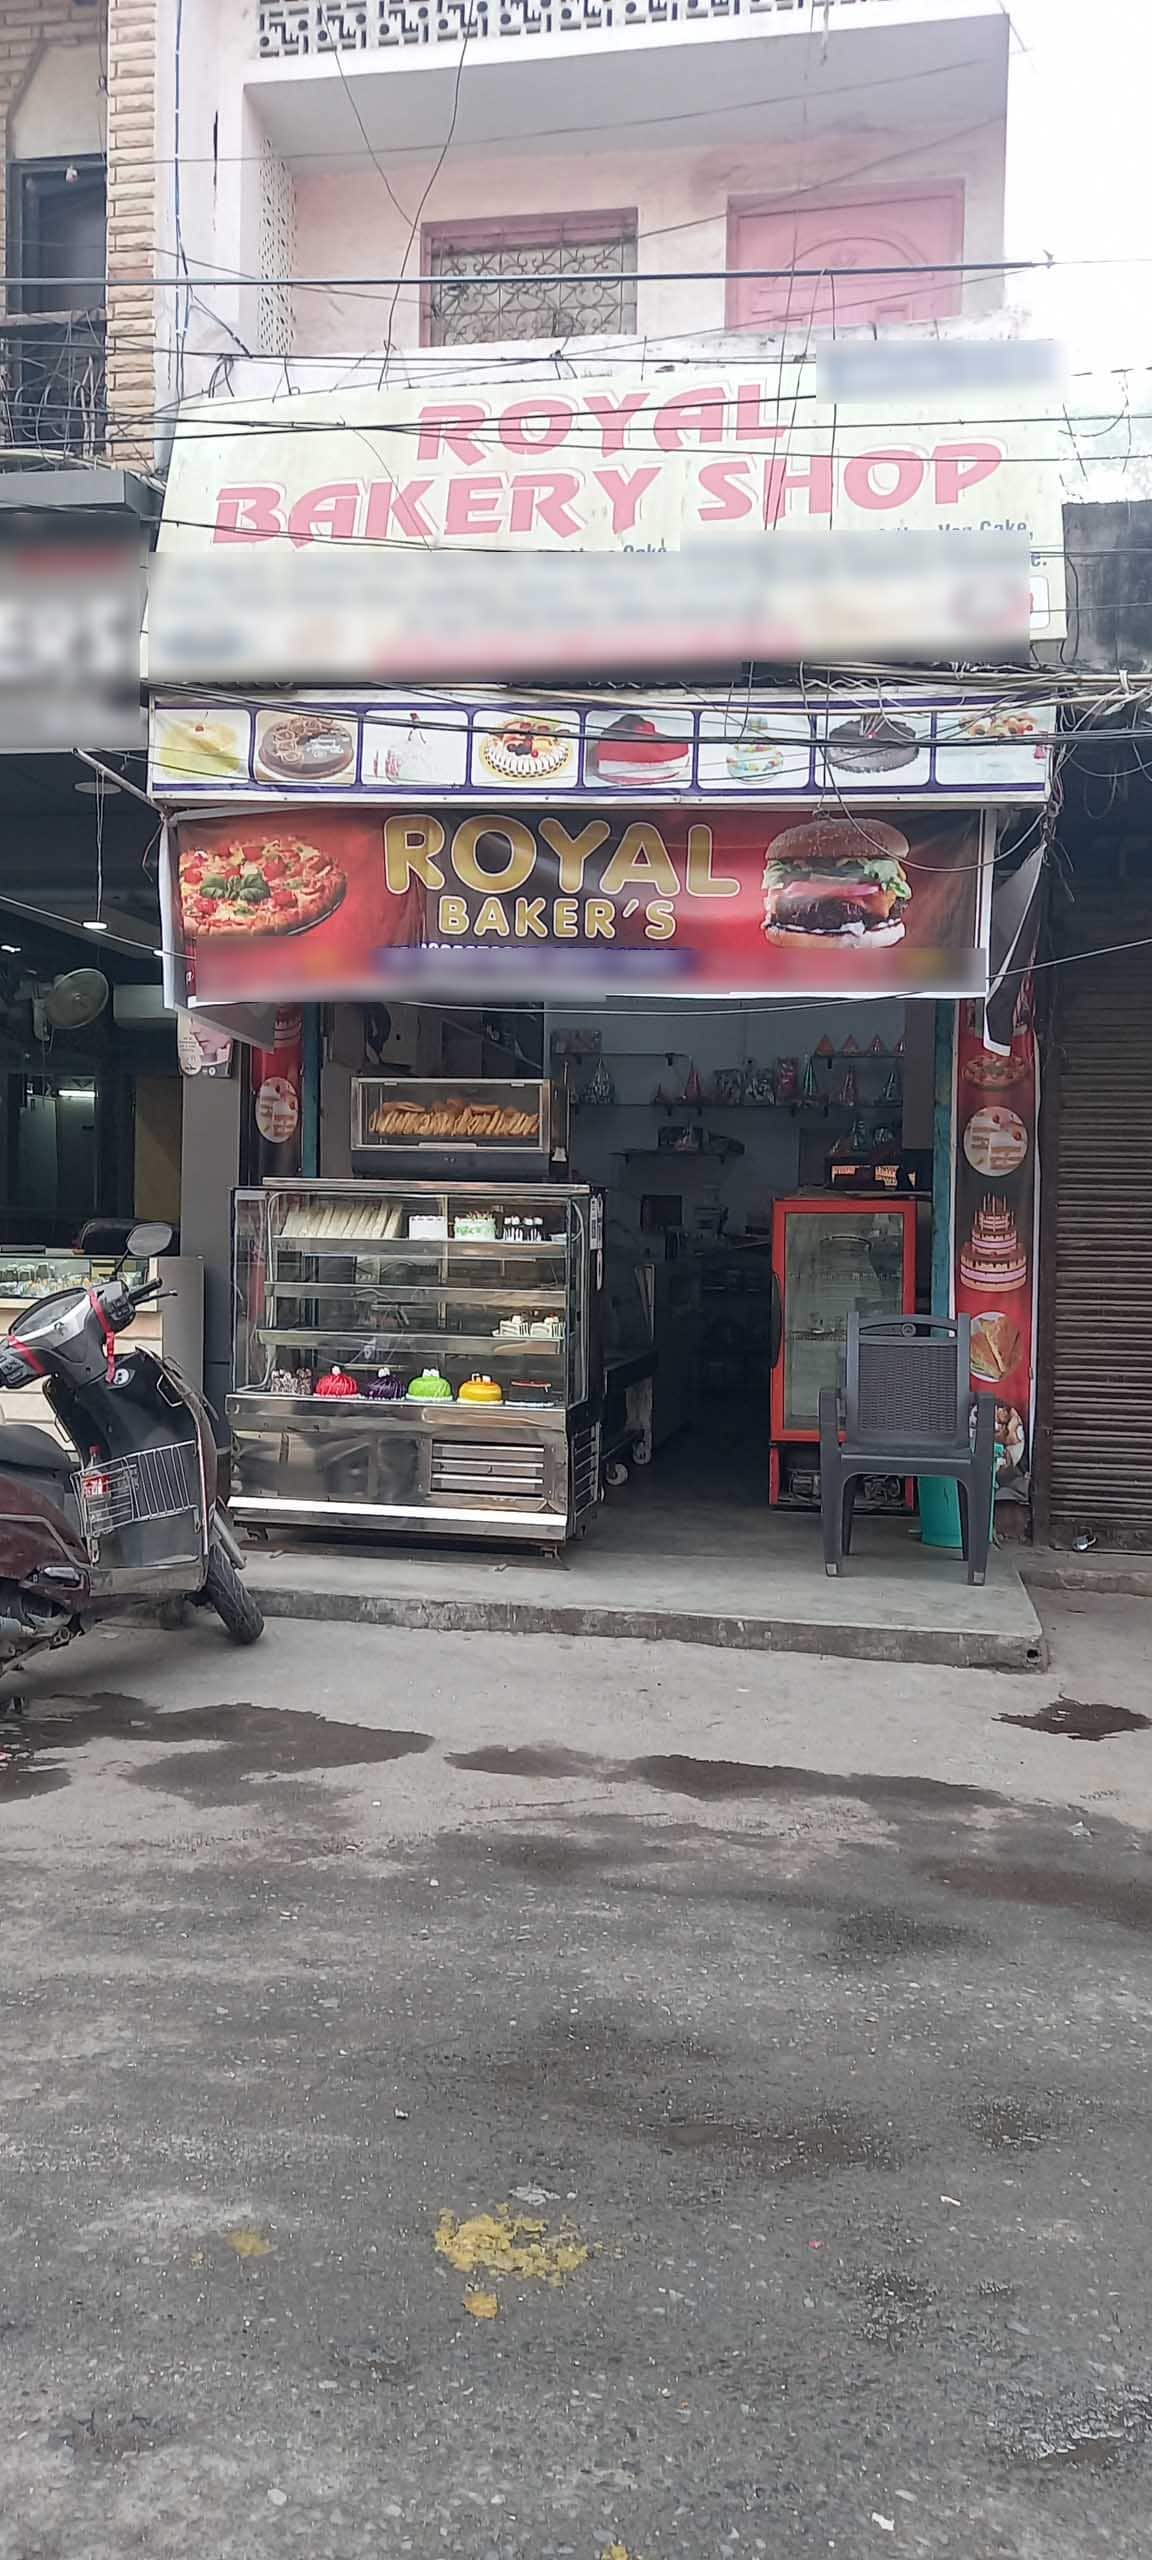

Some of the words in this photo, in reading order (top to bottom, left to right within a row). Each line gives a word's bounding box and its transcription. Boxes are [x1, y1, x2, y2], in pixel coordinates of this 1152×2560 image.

[416, 383, 788, 466] ROYAL
[213, 466, 662, 548] BAKERY
[697, 442, 1003, 525] SHOP
[384, 814, 741, 898] ROYAL
[438, 896, 677, 940] BAKER'S
